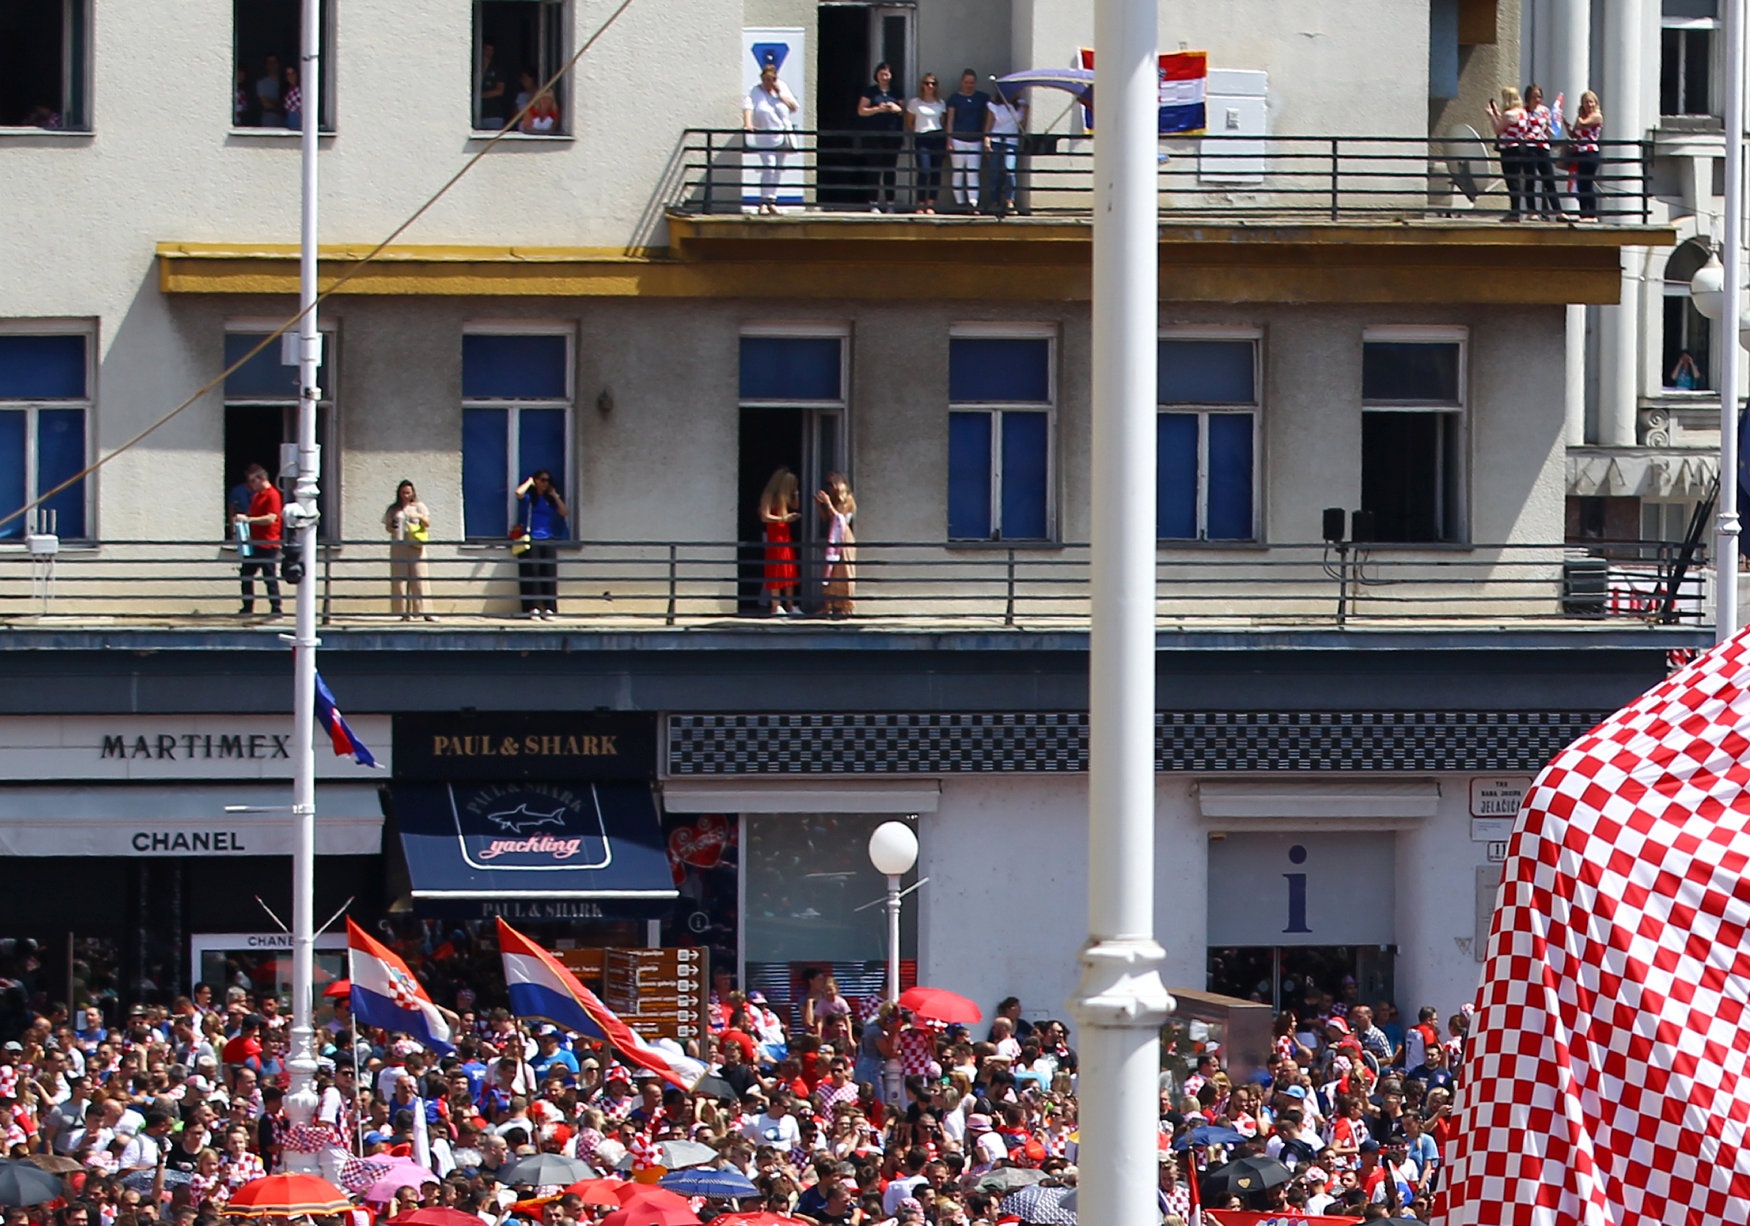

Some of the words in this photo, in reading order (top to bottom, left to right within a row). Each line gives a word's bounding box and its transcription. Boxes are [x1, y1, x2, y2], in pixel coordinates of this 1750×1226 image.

[101, 734, 291, 761] MARTIMEX
[433, 735, 497, 756] PAUL
[499, 735, 520, 756] &
[525, 735, 618, 756] SHARK
[132, 832, 245, 852] CHANEL
[478, 831, 582, 859] yachting
[482, 902, 526, 918] PAUL
[545, 902, 603, 918] SHARK
[247, 935, 293, 947] CHANE
